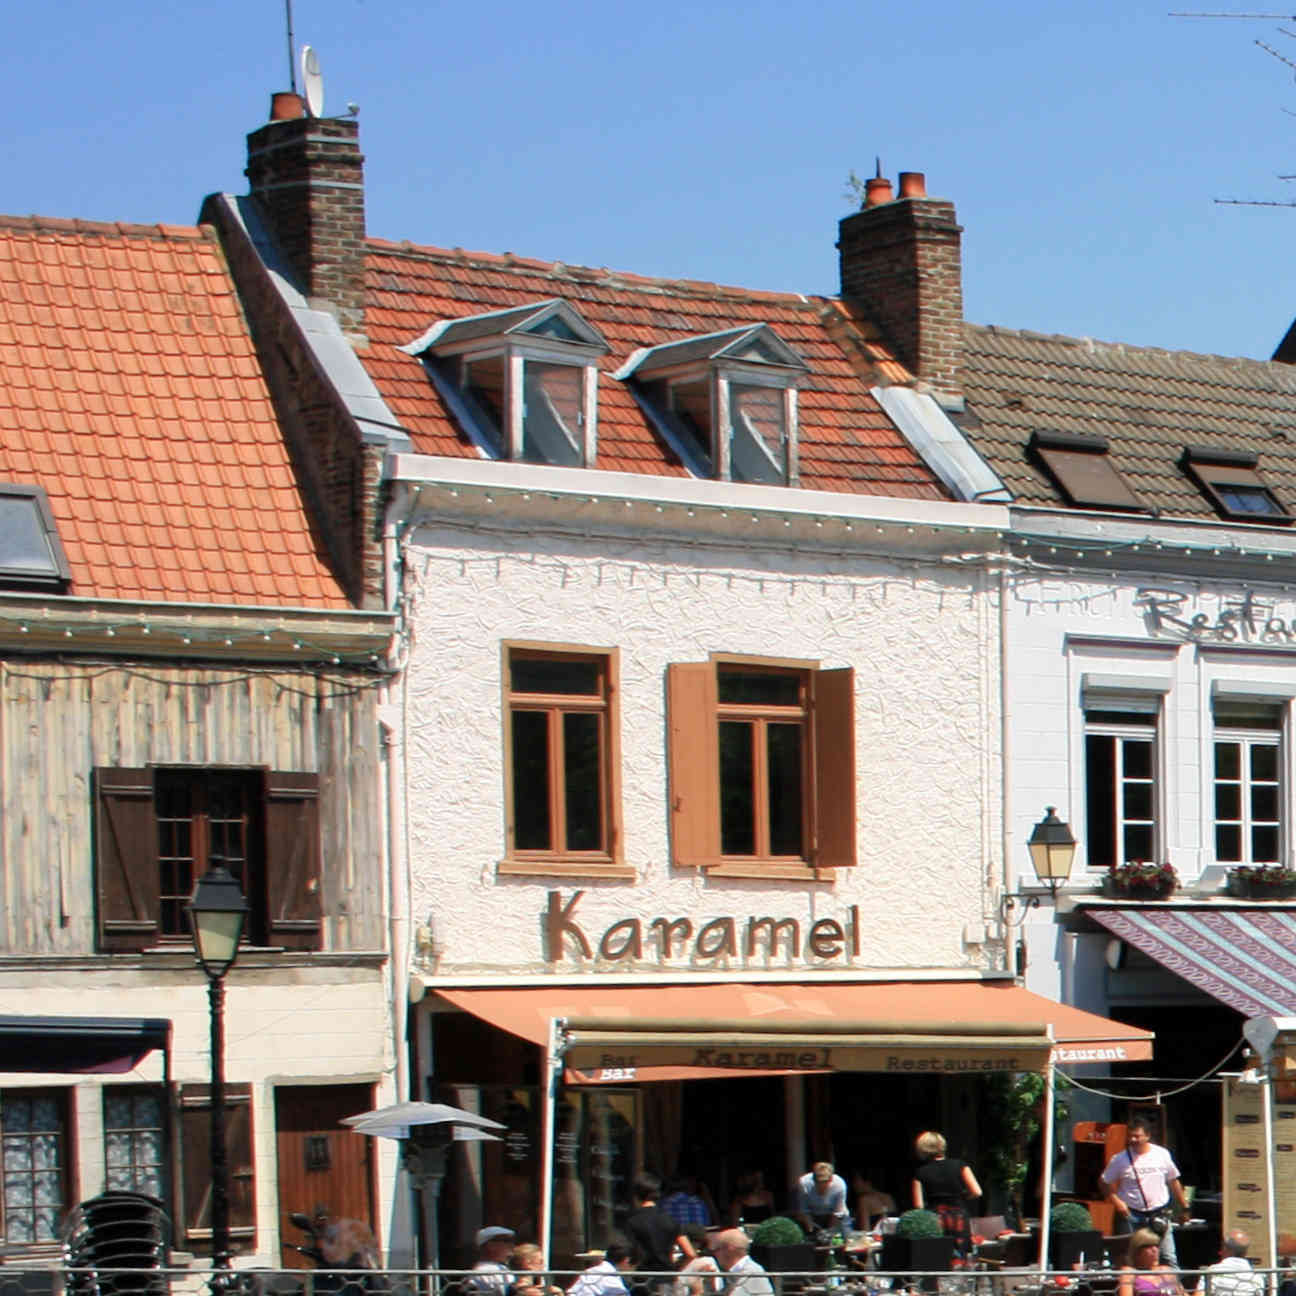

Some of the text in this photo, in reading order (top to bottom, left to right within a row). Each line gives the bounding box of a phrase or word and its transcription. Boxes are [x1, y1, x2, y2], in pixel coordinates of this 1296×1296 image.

[546, 890, 859, 961] Karamel
[691, 1048, 834, 1067] Karamel
[886, 1055, 1019, 1071] Restaurant
